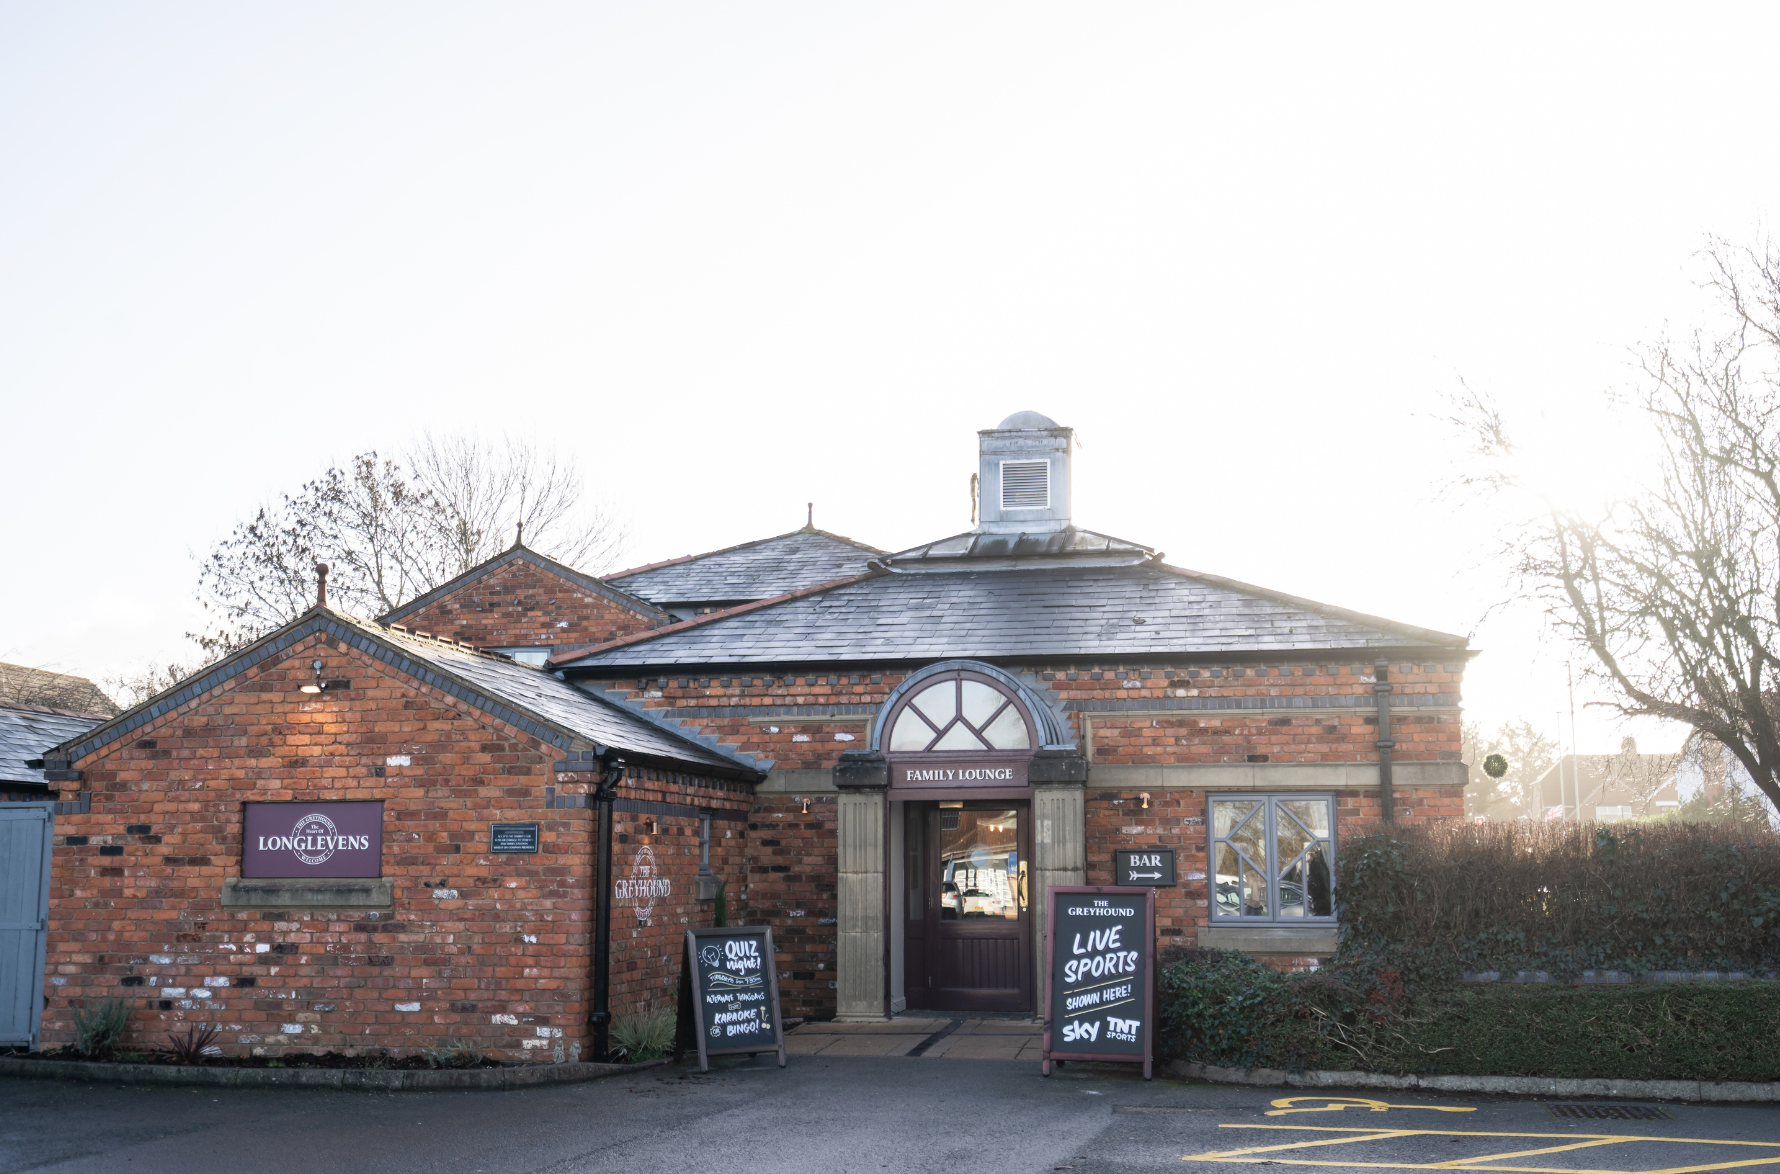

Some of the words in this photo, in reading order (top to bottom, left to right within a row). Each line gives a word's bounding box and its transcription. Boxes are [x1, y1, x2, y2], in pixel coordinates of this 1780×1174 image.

[906, 770, 955, 780] FAMILY
[959, 768, 1013, 780] LOUNGE
[258, 835, 369, 850] LONGLEVENS
[301, 855, 326, 863] WELCOME
[1130, 855, 1163, 867] BAR
[639, 866, 650, 877] THE
[615, 879, 671, 899] GREYHOUND
[1068, 908, 1134, 916] GREYHOUND
[1073, 925, 1123, 955] LIVE
[725, 940, 759, 960] QUIZ
[726, 957, 761, 975] night!
[1064, 951, 1139, 983] SPORTS
[706, 994, 734, 1004] ALTERNATE
[736, 992, 765, 1002] THURSDAYS
[1066, 992, 1100, 1010] SHOWN
[1102, 984, 1132, 1002] HERE!
[714, 1008, 758, 1025] KARAOKE
[727, 1019, 760, 1037] BINGO!
[1062, 1020, 1100, 1042] sky
[1107, 1016, 1141, 1035] TNT
[1106, 1031, 1137, 1042] SPORTS
